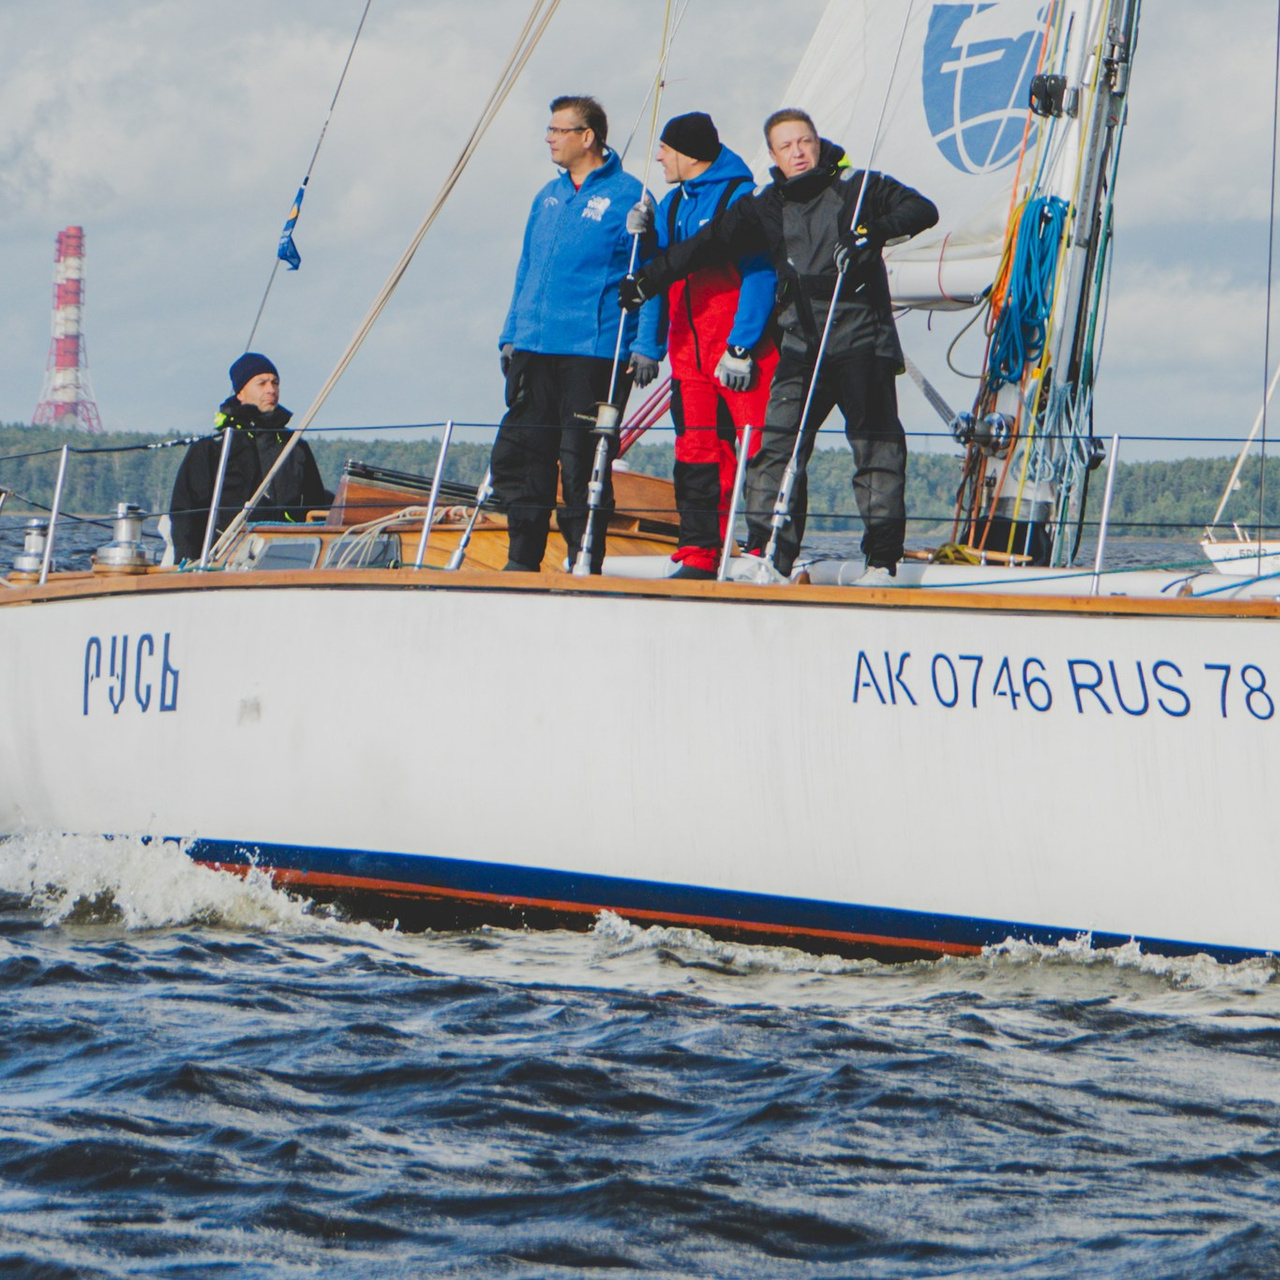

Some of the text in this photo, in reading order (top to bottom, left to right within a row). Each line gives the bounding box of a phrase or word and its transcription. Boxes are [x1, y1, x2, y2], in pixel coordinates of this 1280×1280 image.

[83, 632, 179, 716] РУСЬ
[931, 653, 1053, 712] 0746
[1067, 658, 1192, 717] RUS
[1204, 663, 1276, 720] 78
